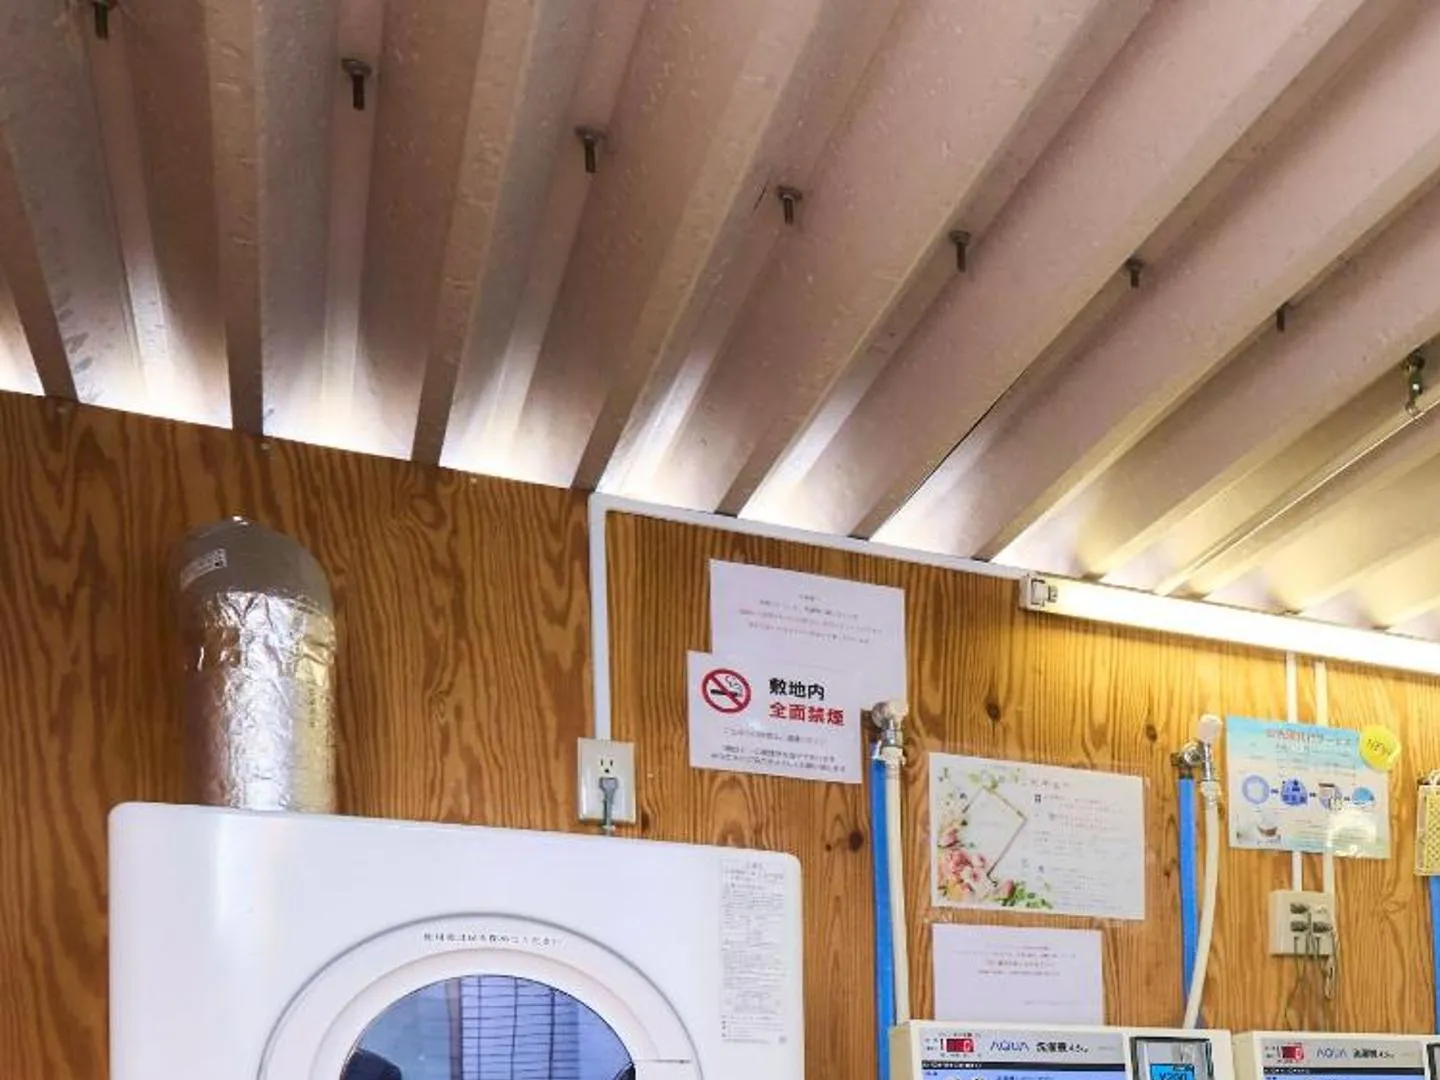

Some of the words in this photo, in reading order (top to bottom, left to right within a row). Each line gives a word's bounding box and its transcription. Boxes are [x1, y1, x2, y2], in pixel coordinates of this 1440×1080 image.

[769, 678, 825, 701] 敷地内
[769, 702, 845, 726] 全面禁煙
